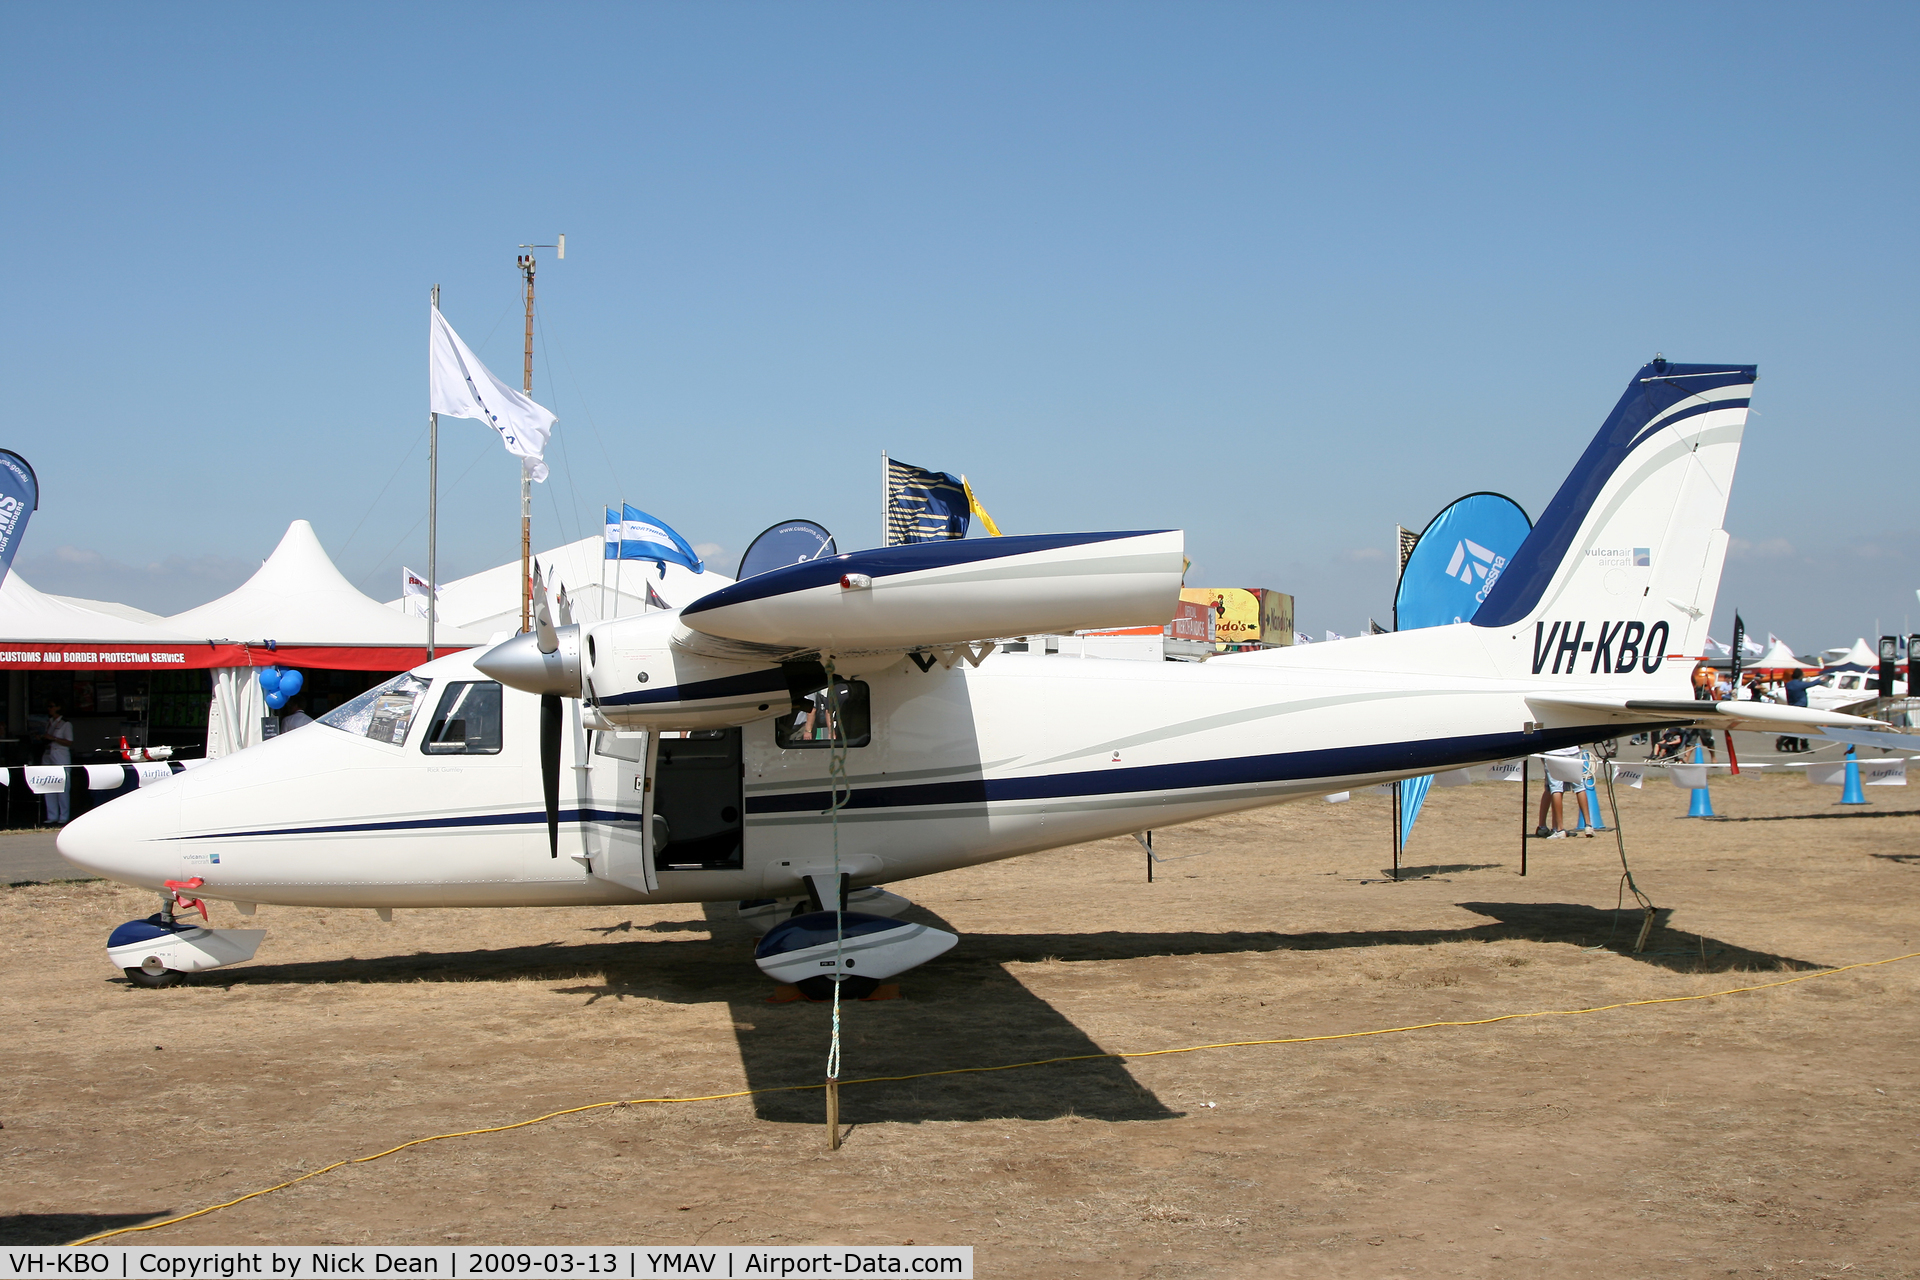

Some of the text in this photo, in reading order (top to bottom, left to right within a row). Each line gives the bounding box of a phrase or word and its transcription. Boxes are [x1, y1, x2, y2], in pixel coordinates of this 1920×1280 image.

[5, 501, 25, 535] BORDERS
[630, 525, 668, 538] NORTHROP
[1584, 547, 1632, 557] vulcanair
[1598, 557, 1632, 567] aircraft
[1475, 555, 1506, 604] Cessna
[1531, 620, 1671, 675] VH-KBO
[0, 651, 186, 664] CUSTOMS AND BORDER PROTECTION SERVICE
[141, 769, 171, 780] Airflite
[1488, 764, 1521, 774] Airflite
[1868, 769, 1904, 779] Airflite
[29, 775, 64, 786] Airflite
